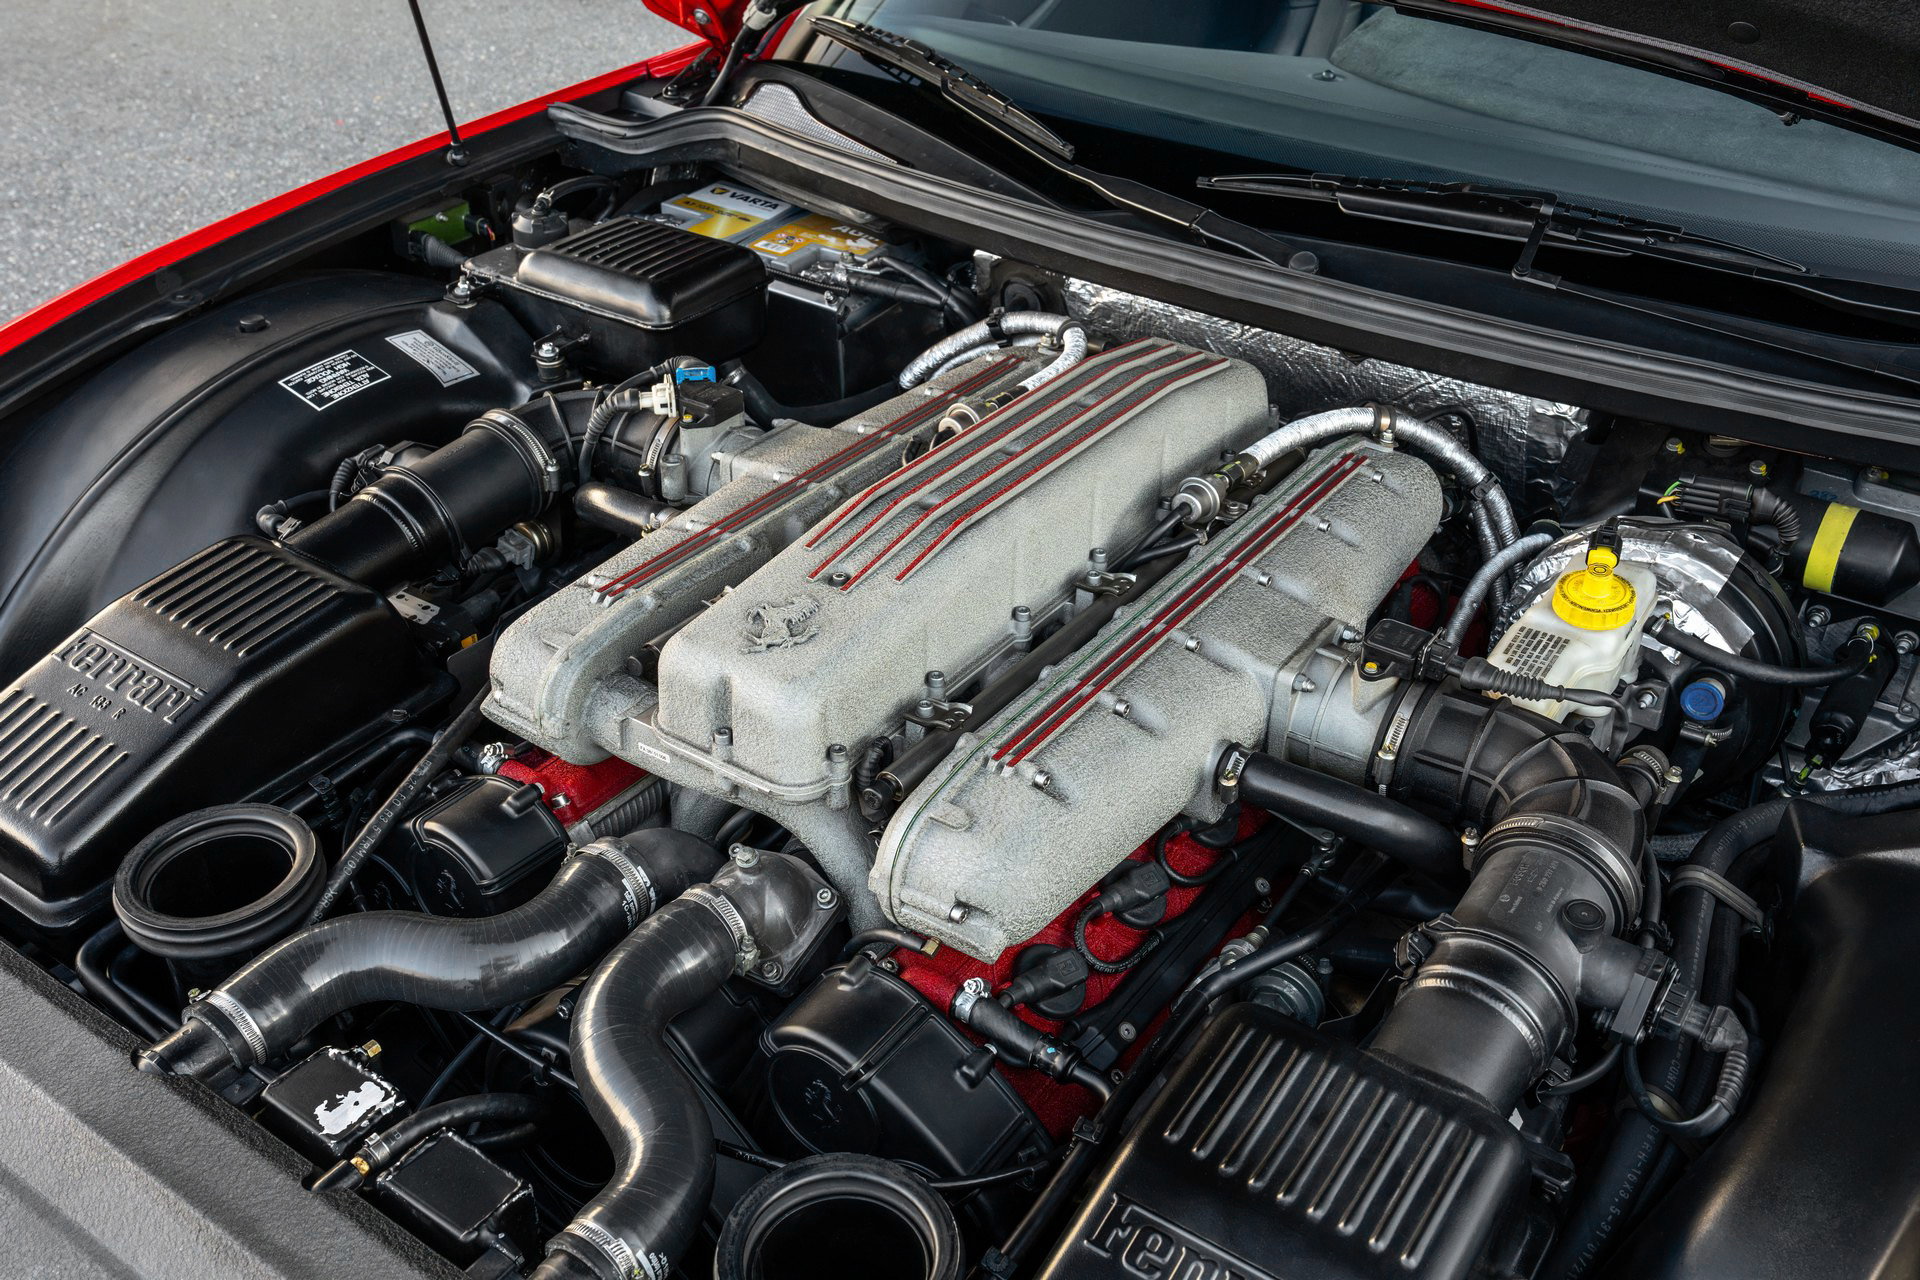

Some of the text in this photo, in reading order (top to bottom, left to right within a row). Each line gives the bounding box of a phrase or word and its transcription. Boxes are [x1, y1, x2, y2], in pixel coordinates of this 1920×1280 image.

[729, 191, 779, 209] VARTA
[302, 360, 351, 384] HIGH VOLTAGE
[317, 367, 350, 384] WARNING
[319, 372, 371, 398] ALTA TENSIONE
[329, 378, 372, 399] ATTENZIONE
[50, 622, 208, 725] Ferrari
